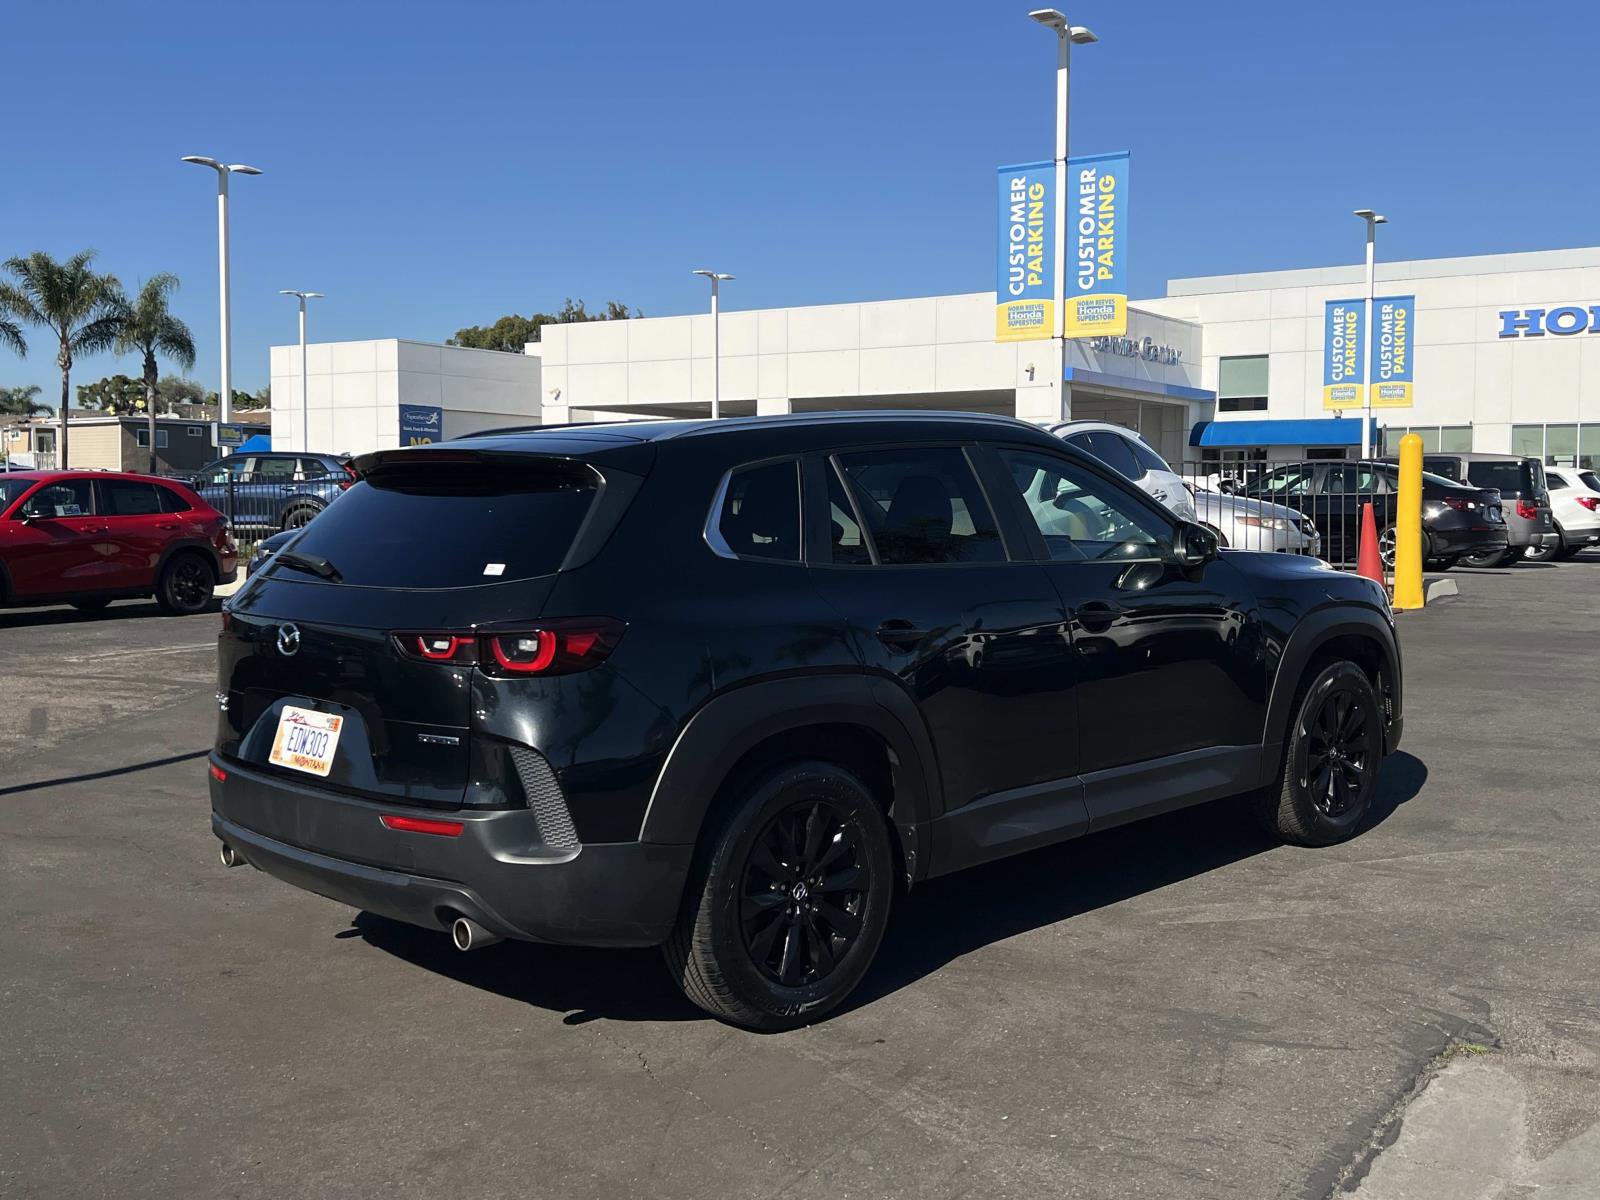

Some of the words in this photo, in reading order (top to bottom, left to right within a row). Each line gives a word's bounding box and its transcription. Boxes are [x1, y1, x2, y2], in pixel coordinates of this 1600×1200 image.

[1009, 176, 1026, 295] CUSTOMER
[1027, 182, 1045, 286] PARKING
[1078, 167, 1096, 290] CUSTOMER
[1097, 174, 1116, 280] PARKING
[1009, 310, 1042, 320] Honda
[1024, 303, 1044, 311] REEVES
[1077, 313, 1115, 322] SUPERSTORE
[1079, 305, 1113, 315] Honda
[1095, 298, 1115, 306] REEVES
[1008, 318, 1044, 327] SUPERSTORE
[1498, 305, 1600, 339] HO
[1139, 336, 1182, 366] Center
[1332, 307, 1345, 381] CUSTOMER
[1345, 311, 1358, 376] PARKING
[1381, 304, 1393, 379] CUSTOMER
[1394, 308, 1406, 374] PARKING
[287, 726, 329, 758] EDW303
[294, 755, 325, 770] MONTANA
